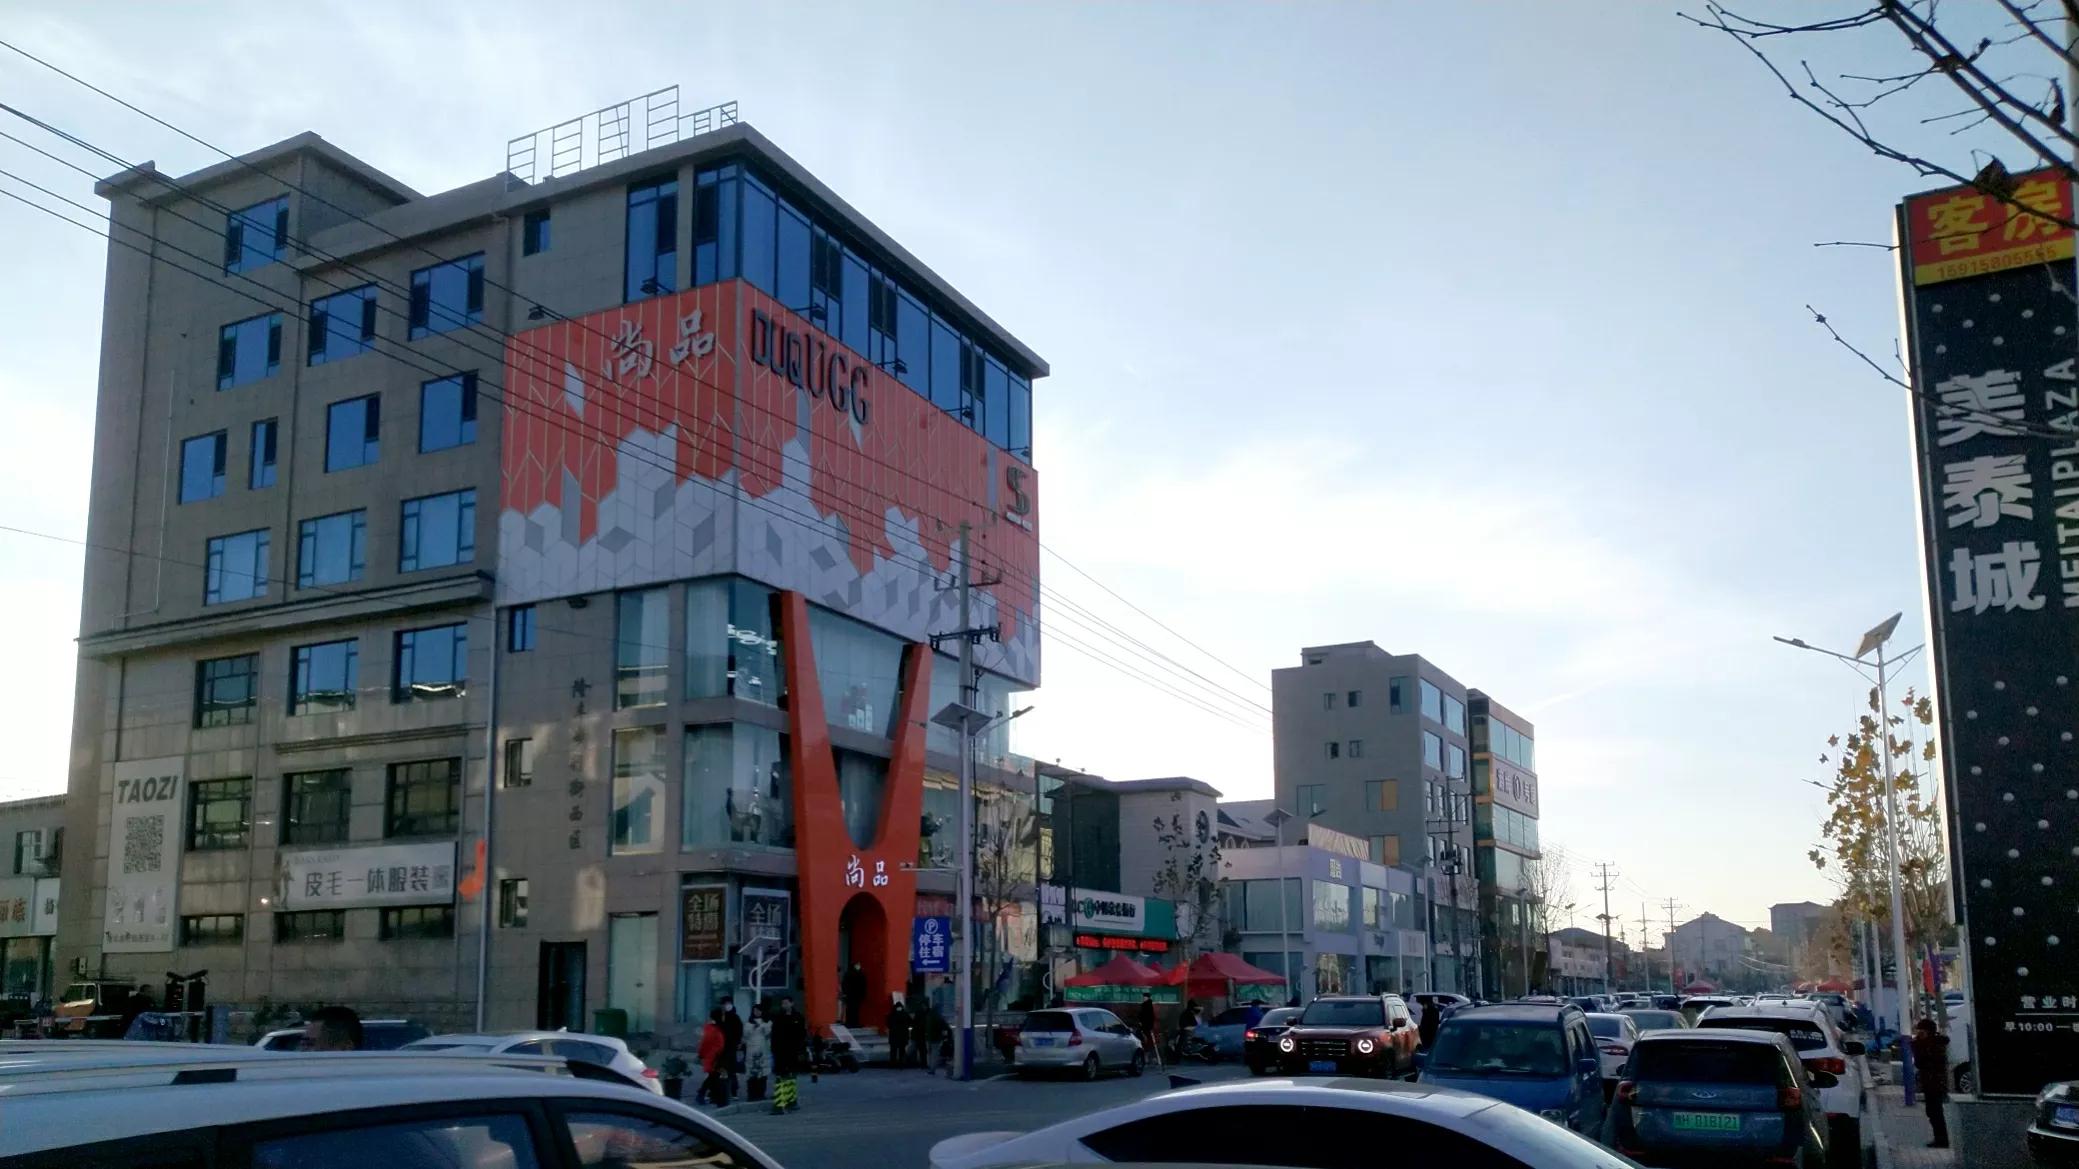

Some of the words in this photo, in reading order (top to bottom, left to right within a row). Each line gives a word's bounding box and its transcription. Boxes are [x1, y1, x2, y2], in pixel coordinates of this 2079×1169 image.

[1927, 180, 2063, 255] 客房
[607, 309, 715, 379] 尚品
[1936, 369, 2046, 616] 美泰城
[117, 775, 179, 804] TAOZI
[304, 865, 430, 898] 皮毛一体服装
[845, 854, 889, 888] 尚品
